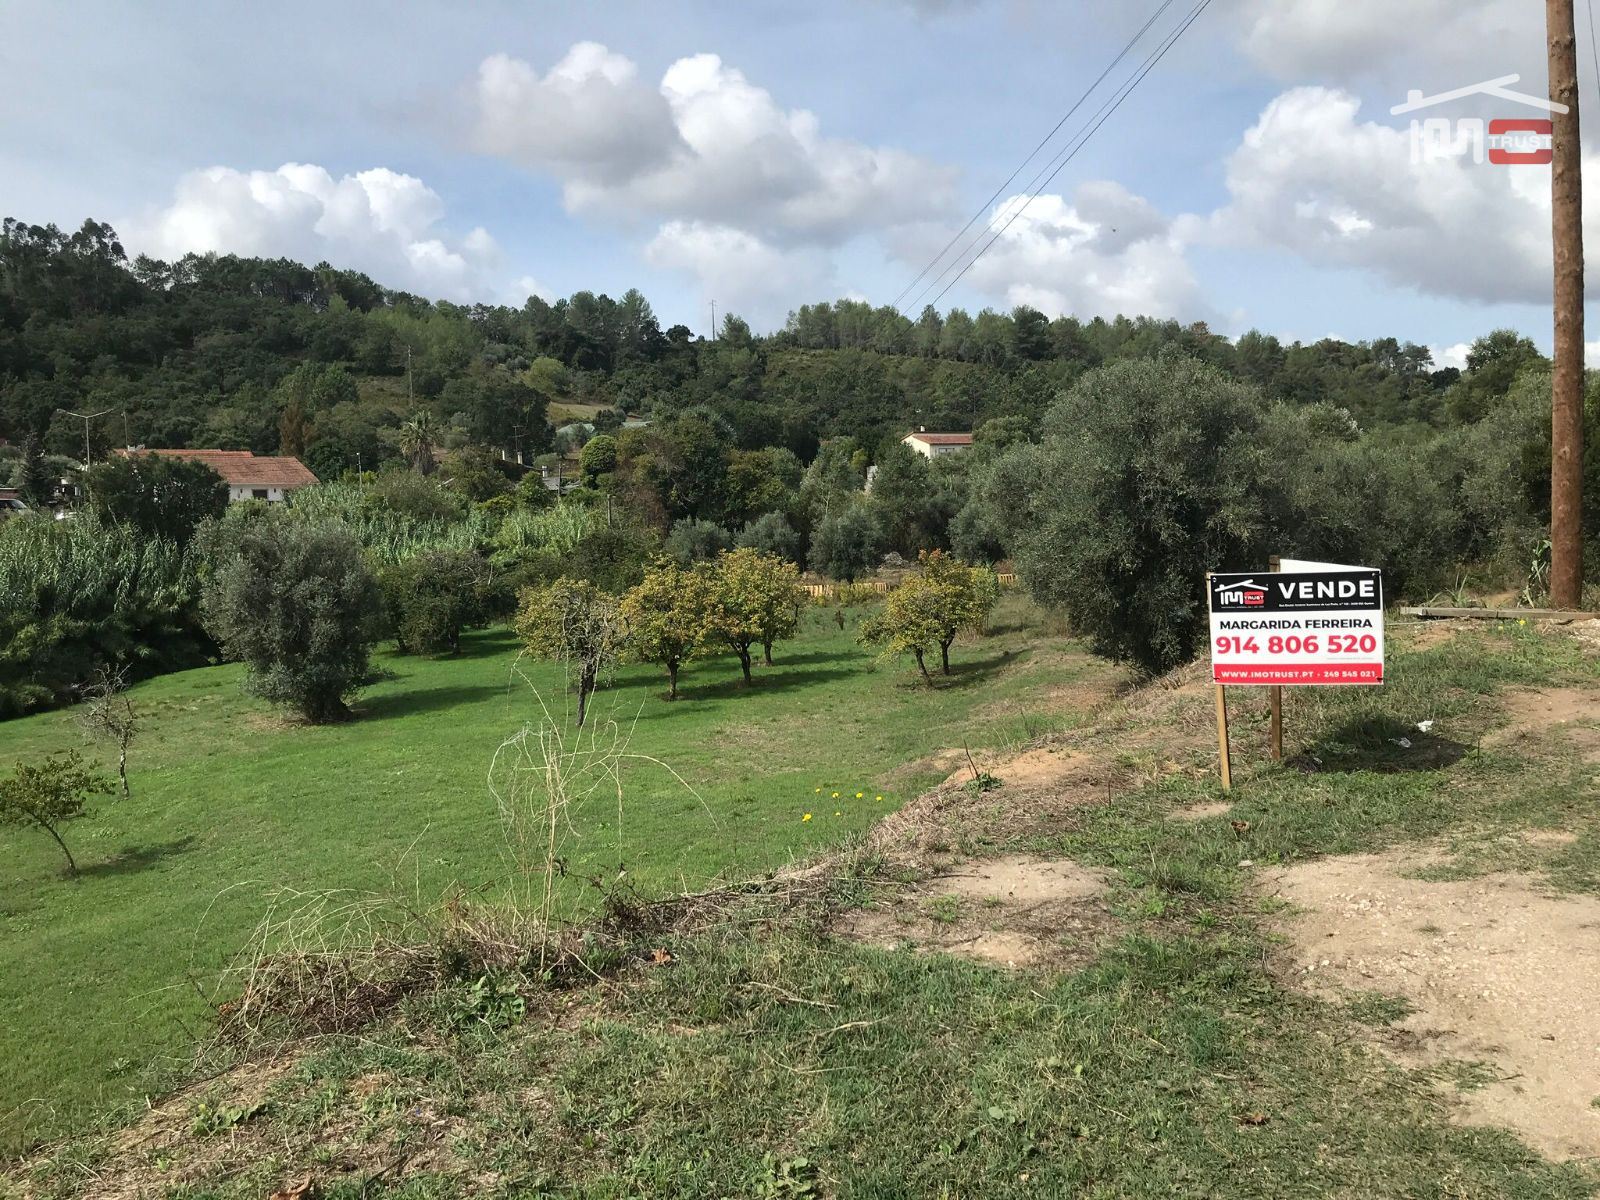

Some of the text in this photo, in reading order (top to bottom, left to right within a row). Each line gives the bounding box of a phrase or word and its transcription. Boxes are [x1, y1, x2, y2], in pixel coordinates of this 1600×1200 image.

[1278, 580, 1375, 600] VENDE
[1220, 618, 1373, 630] MARGARIDA FERREIRA
[1216, 634, 1377, 654] 914 806 520
[1221, 671, 1314, 679] WWW.IMOTRUST.PT
